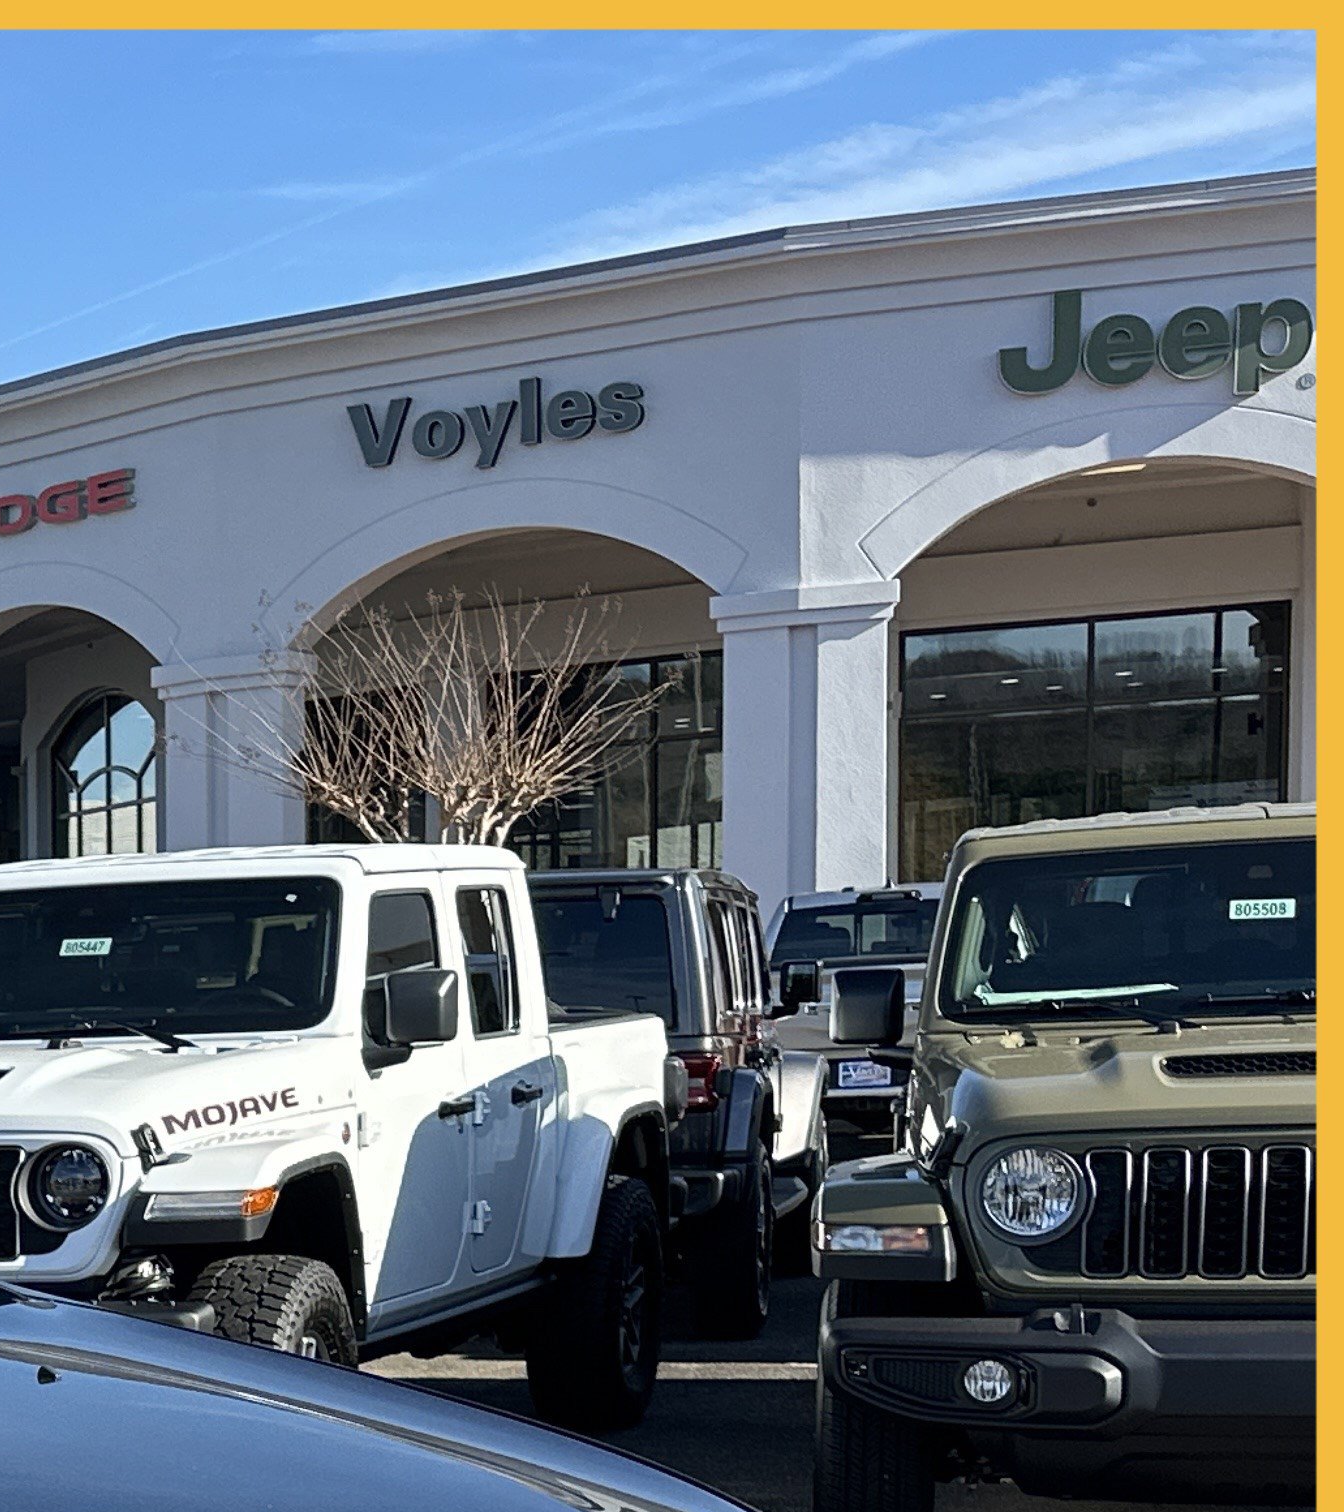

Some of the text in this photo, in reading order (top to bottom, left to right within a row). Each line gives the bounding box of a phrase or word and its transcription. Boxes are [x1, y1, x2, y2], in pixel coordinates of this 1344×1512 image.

[999, 288, 1312, 395] Jeep
[346, 376, 646, 469] Voyles
[1235, 902, 1287, 916] 805508
[162, 1087, 299, 1135] MOJAVE
